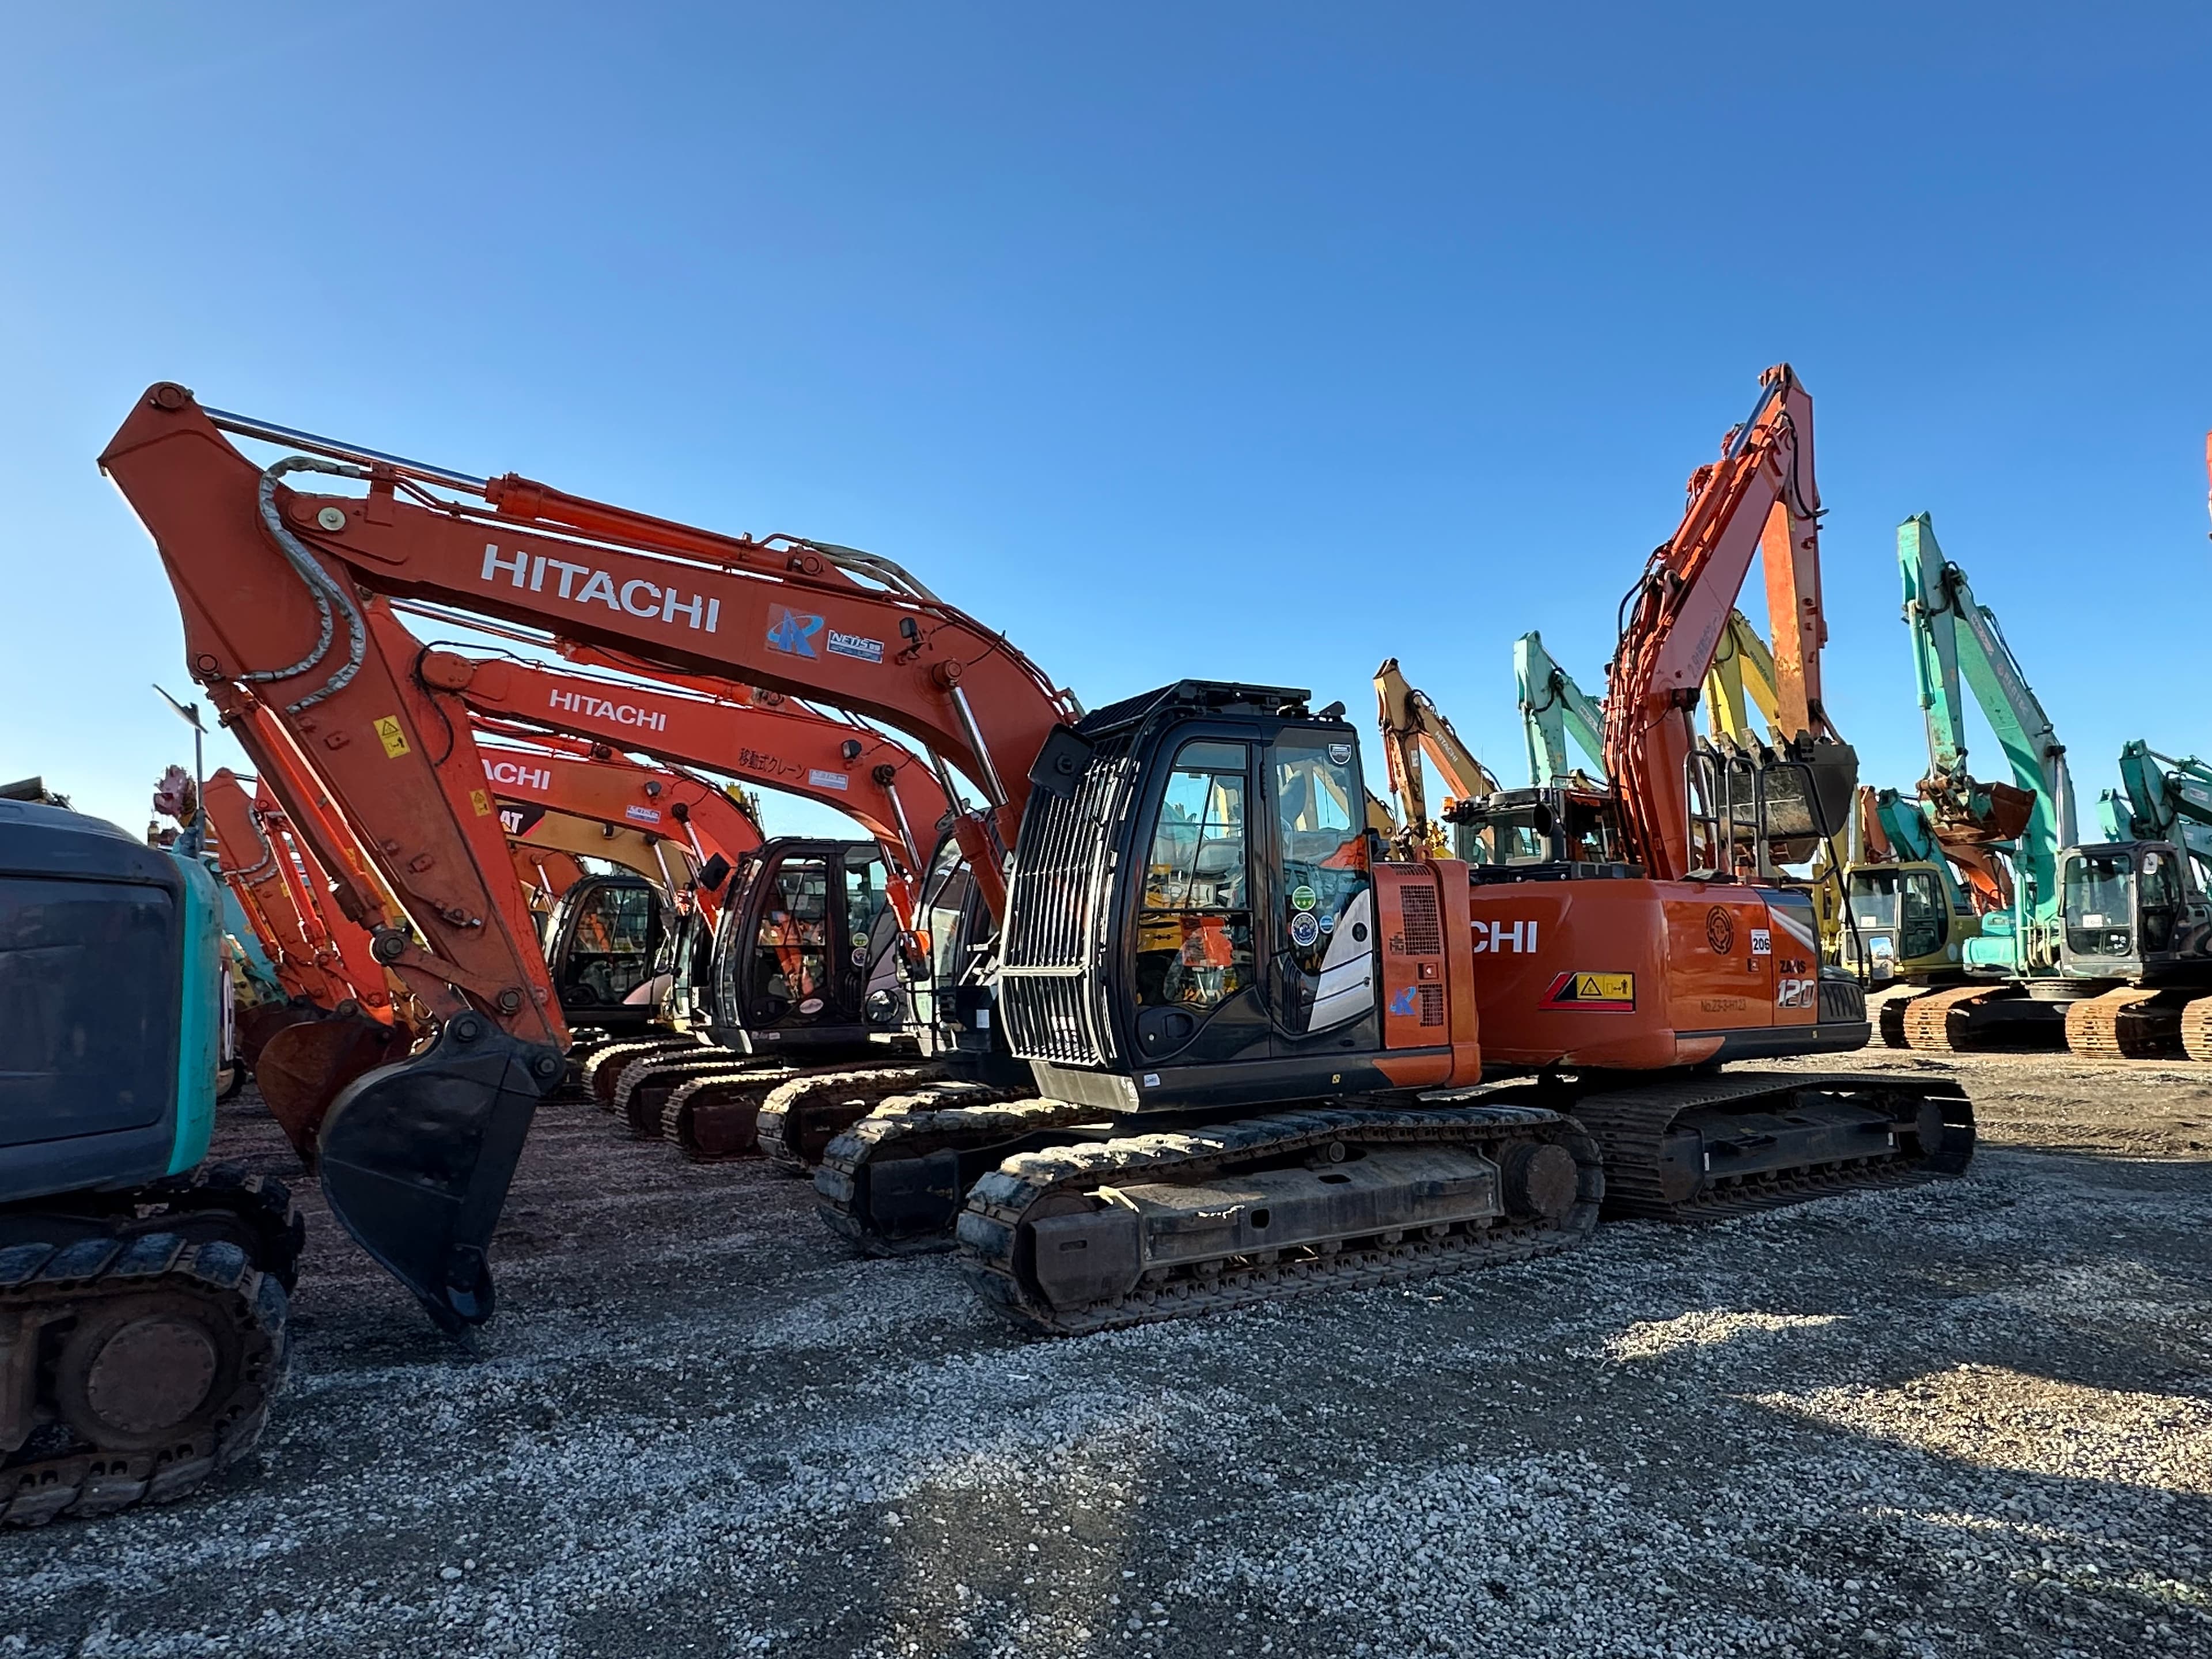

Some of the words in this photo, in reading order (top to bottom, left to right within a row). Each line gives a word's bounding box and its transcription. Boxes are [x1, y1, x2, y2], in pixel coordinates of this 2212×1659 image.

[481, 544, 720, 634] HITACHI
[549, 689, 668, 732] HITACHI
[1434, 730, 1459, 763] HITACHI
[738, 747, 806, 780] 移動式クレーン
[1472, 921, 1538, 953] CHI
[1779, 959, 1806, 975] ZAXIS
[1778, 979, 1815, 1009] 120
